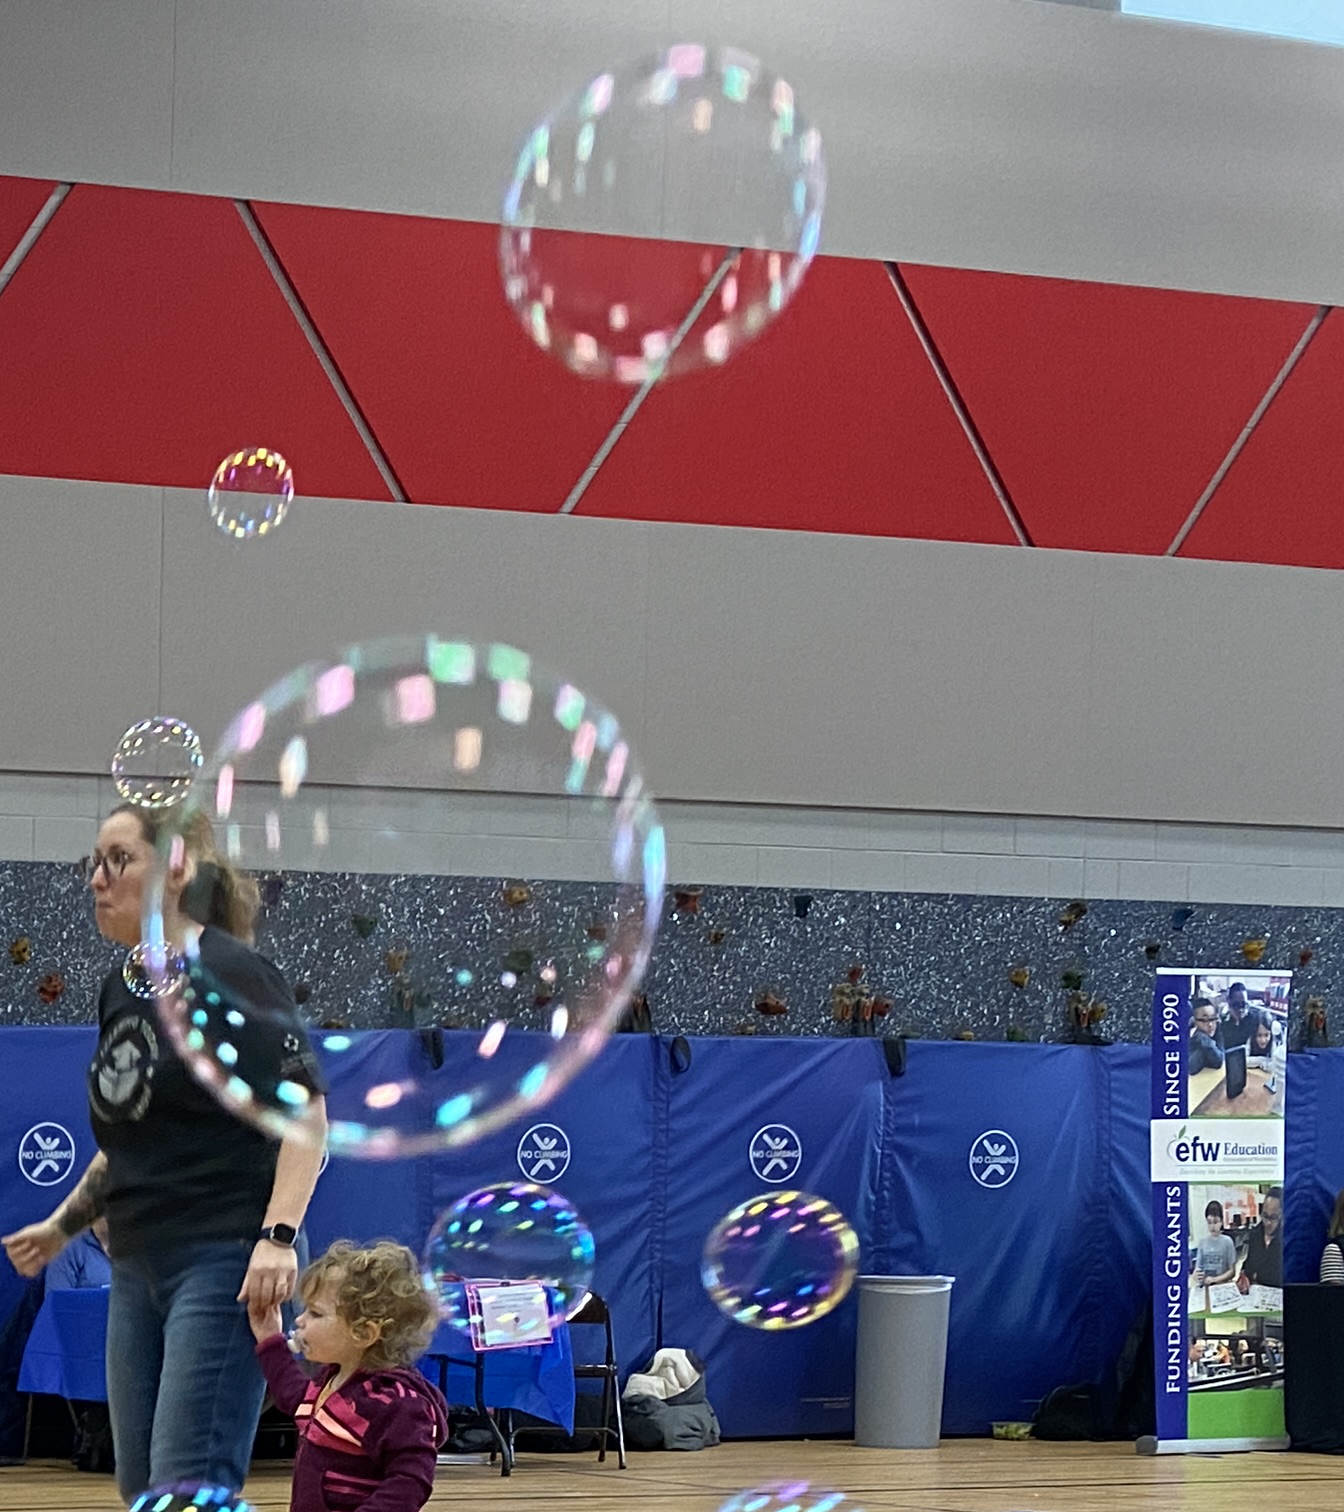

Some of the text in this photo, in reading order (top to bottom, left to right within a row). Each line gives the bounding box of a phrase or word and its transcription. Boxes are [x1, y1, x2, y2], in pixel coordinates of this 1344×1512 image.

[1162, 993, 1180, 1116] SINCE 1990
[520, 1150, 533, 1159] NO
[752, 1150, 764, 1158] NO
[1175, 1135, 1221, 1162] efw
[1223, 1141, 1279, 1156] Education
[22, 1150, 34, 1160] NO
[972, 1156, 983, 1164] NO
[1165, 1185, 1181, 1394] FUNDING GRANTS
